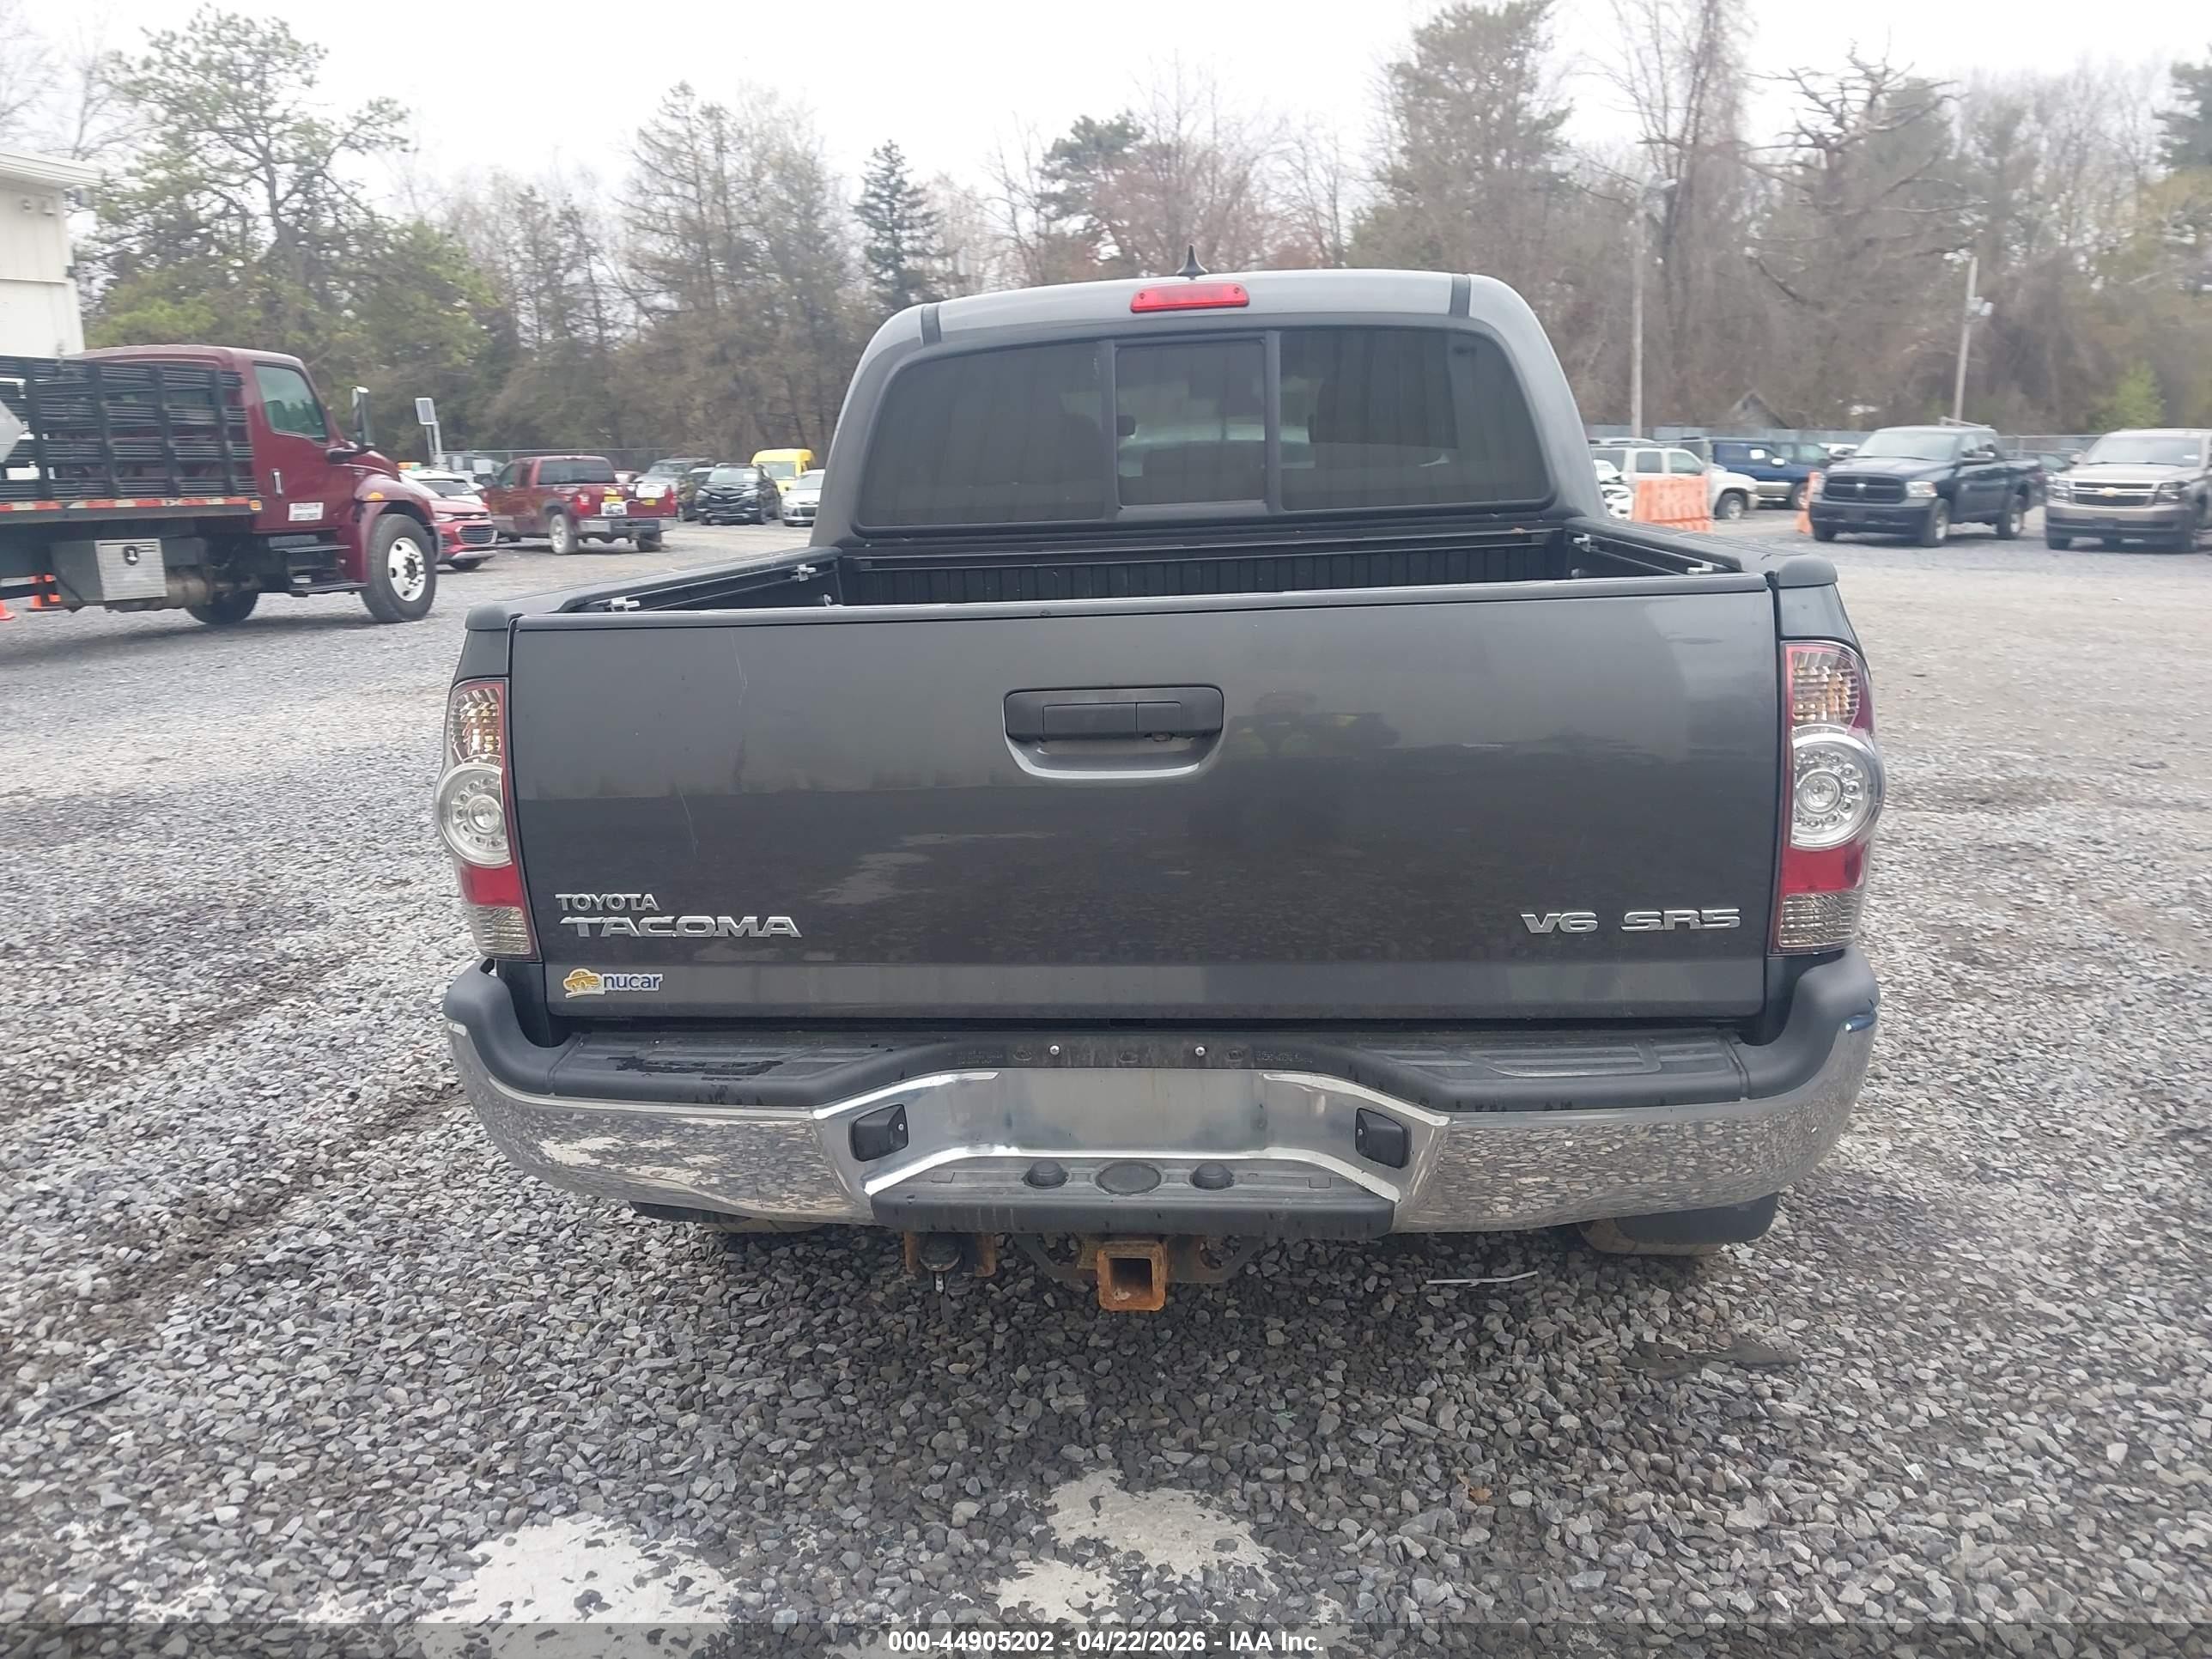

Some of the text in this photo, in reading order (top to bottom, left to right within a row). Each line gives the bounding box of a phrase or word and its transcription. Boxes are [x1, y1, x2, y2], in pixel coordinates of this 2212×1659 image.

[555, 893, 659, 911] TOYOTA
[559, 915, 803, 938] TACOMA
[1520, 908, 1741, 934] V6 SR5
[604, 973, 662, 991] nucar
